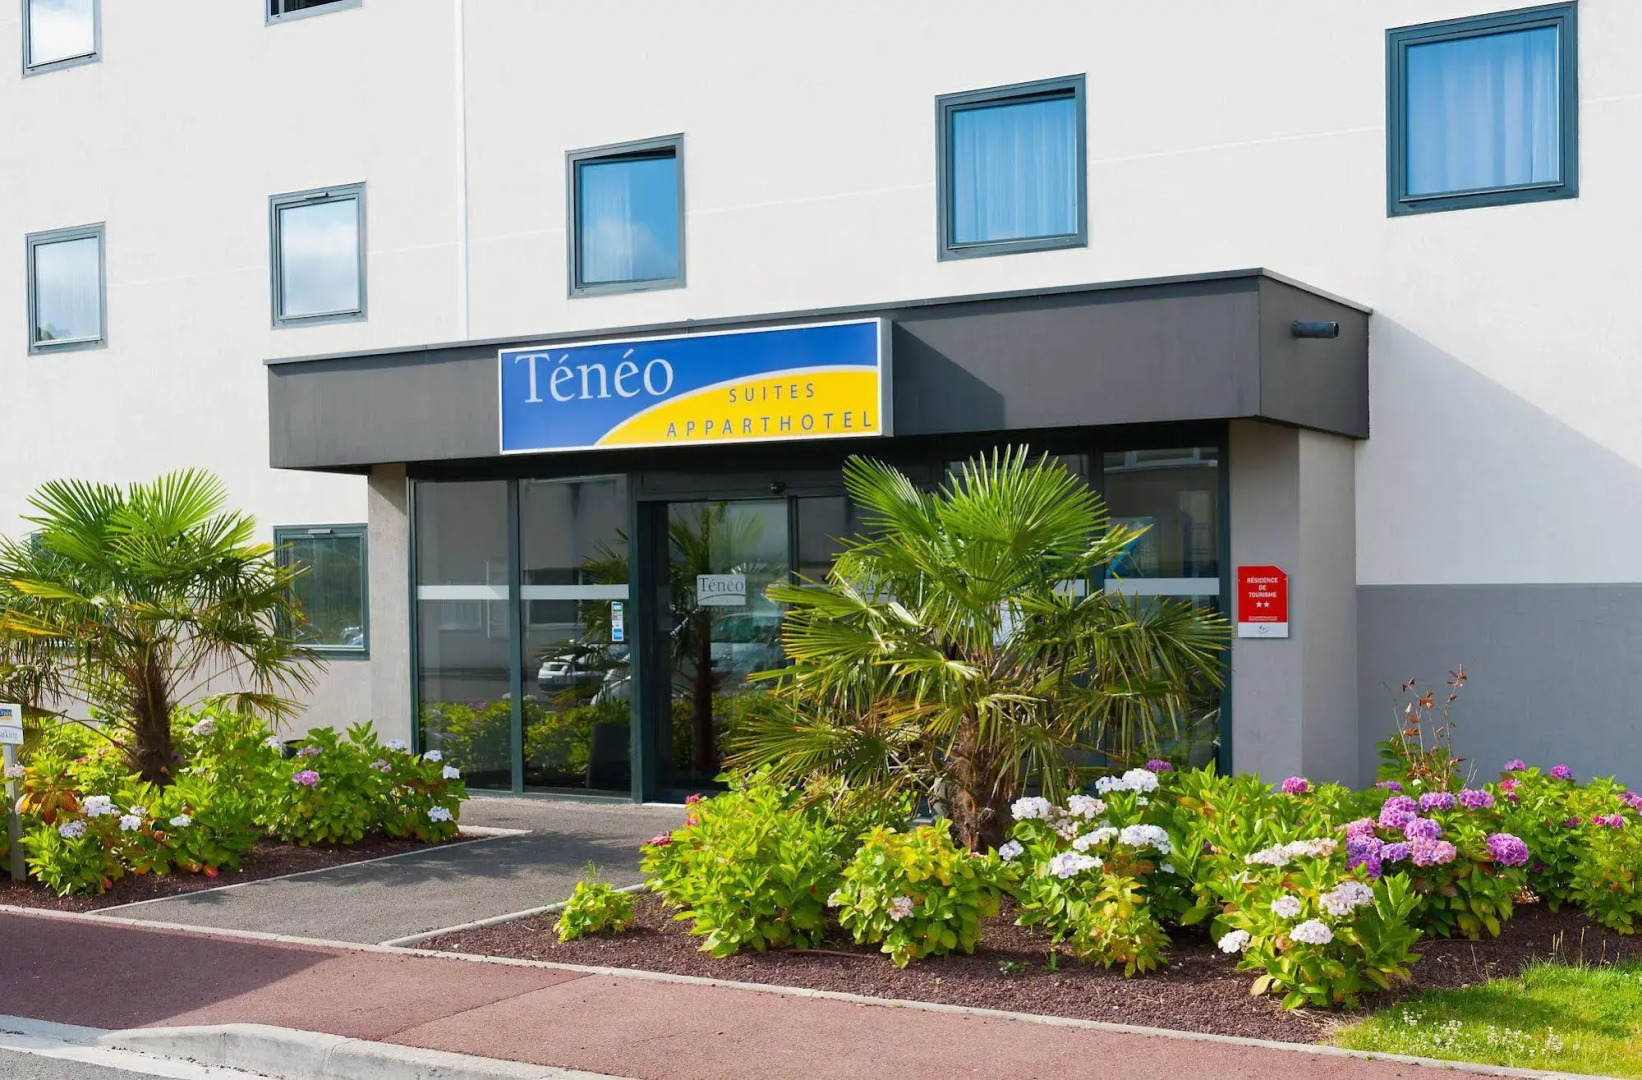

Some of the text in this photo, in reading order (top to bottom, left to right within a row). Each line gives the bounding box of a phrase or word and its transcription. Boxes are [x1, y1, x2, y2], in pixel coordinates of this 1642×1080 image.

[515, 348, 674, 404] Ténéo
[729, 383, 815, 403] SUITES
[667, 410, 872, 438] APPARTHOTEL
